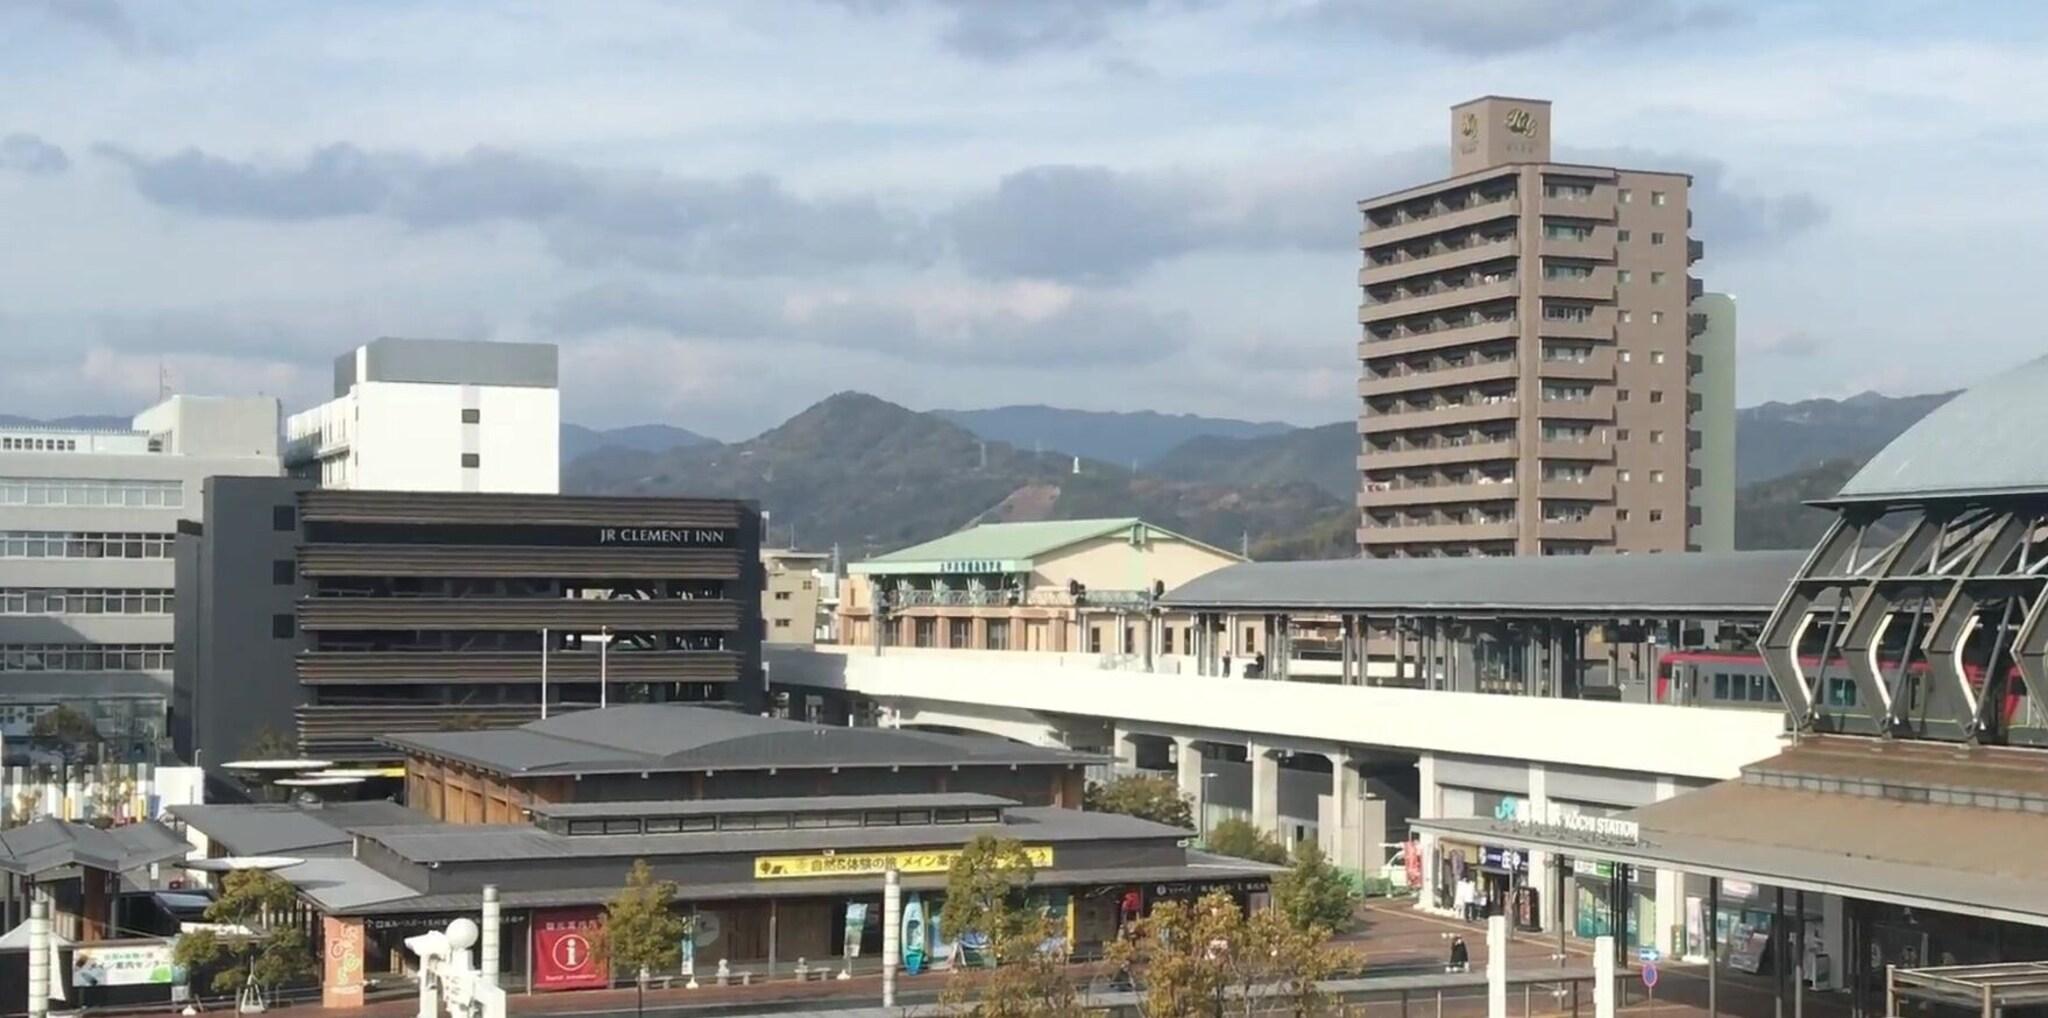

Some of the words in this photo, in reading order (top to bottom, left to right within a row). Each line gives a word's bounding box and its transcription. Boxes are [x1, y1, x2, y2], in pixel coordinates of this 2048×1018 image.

[600, 528, 616, 544] JR
[620, 529, 690, 542] CLEMENT
[695, 530, 724, 543] INN
[1596, 817, 1639, 838] STATION
